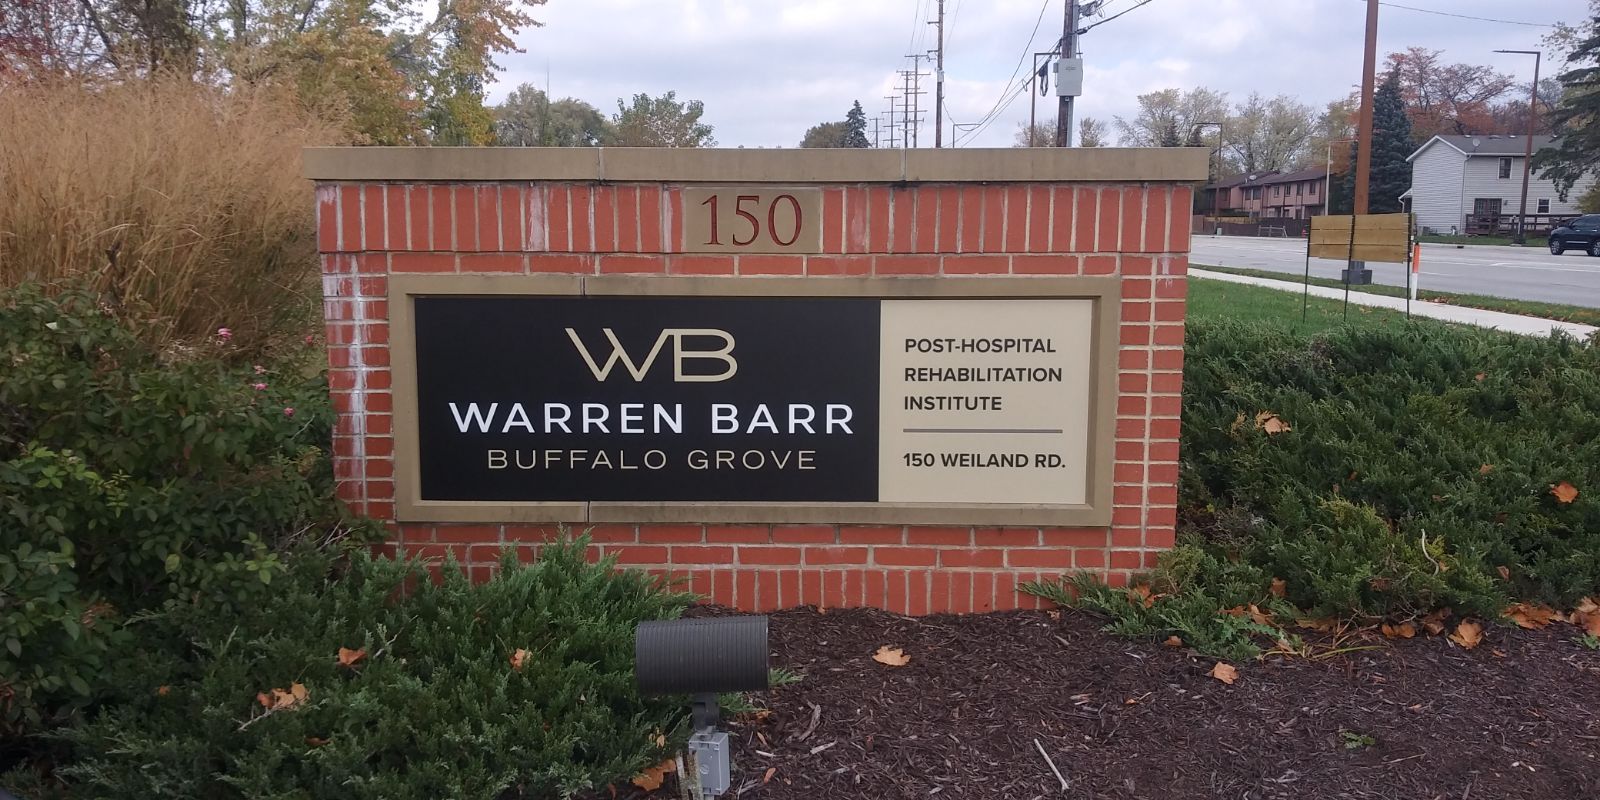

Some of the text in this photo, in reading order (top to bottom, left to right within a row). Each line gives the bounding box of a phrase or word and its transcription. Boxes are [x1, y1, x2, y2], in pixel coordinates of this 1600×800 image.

[700, 194, 803, 247] 150
[564, 327, 738, 383] WB
[904, 338, 1057, 353] POST-HOSPITAL
[904, 367, 1062, 382] REHABILITATION
[903, 396, 1002, 411] INSTITUTE
[448, 402, 855, 435] WARREN BARR
[487, 449, 817, 471] BUFFALO GROVE
[903, 453, 1067, 469] 150 WEILAND RD.
